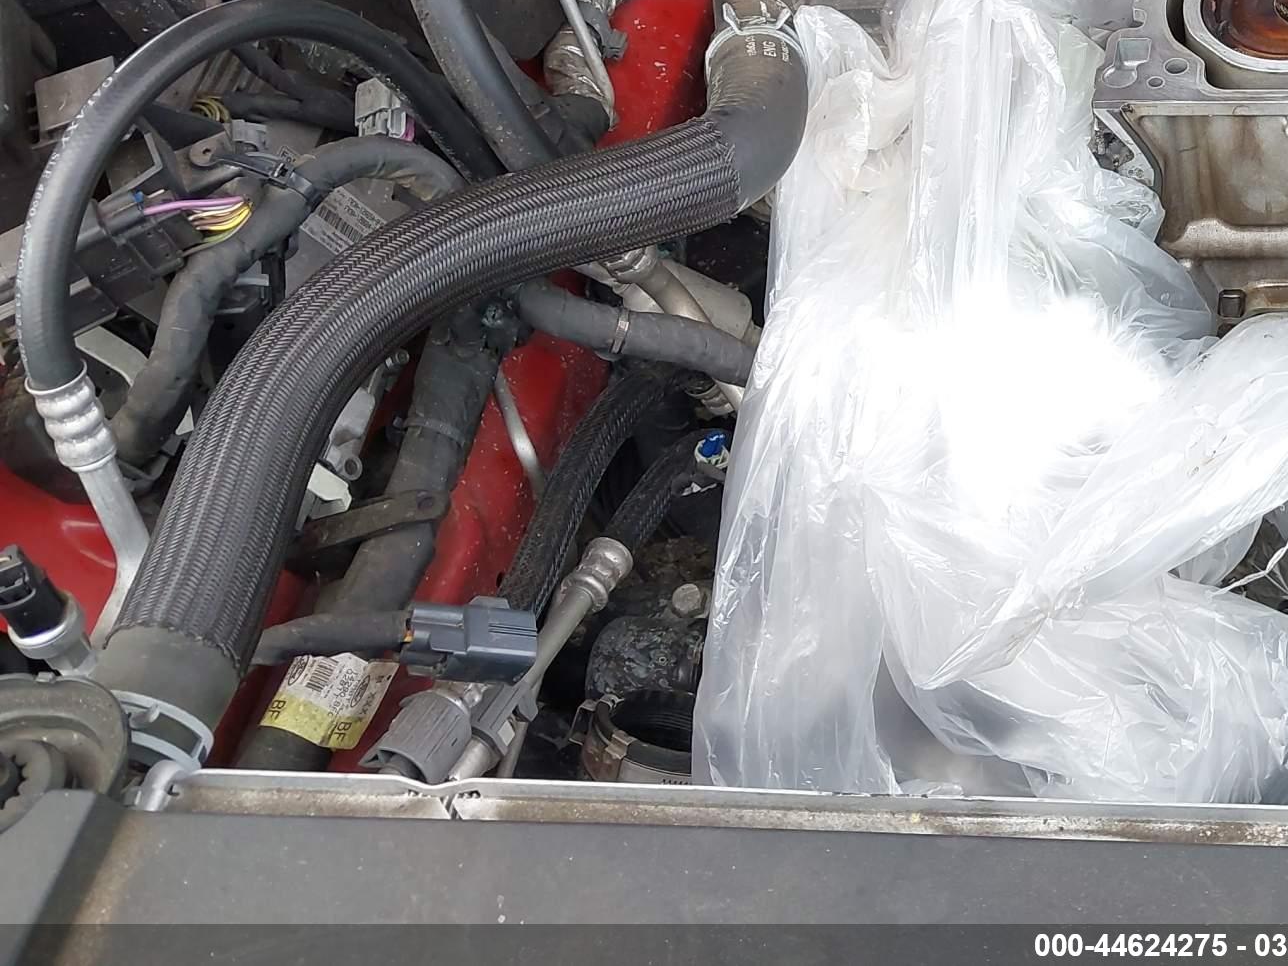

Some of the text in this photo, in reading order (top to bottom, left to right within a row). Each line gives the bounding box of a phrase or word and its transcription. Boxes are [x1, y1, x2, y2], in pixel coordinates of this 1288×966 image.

[763, 41, 776, 56] ENG
[268, 700, 286, 720] BF
[333, 721, 352, 742] BF
